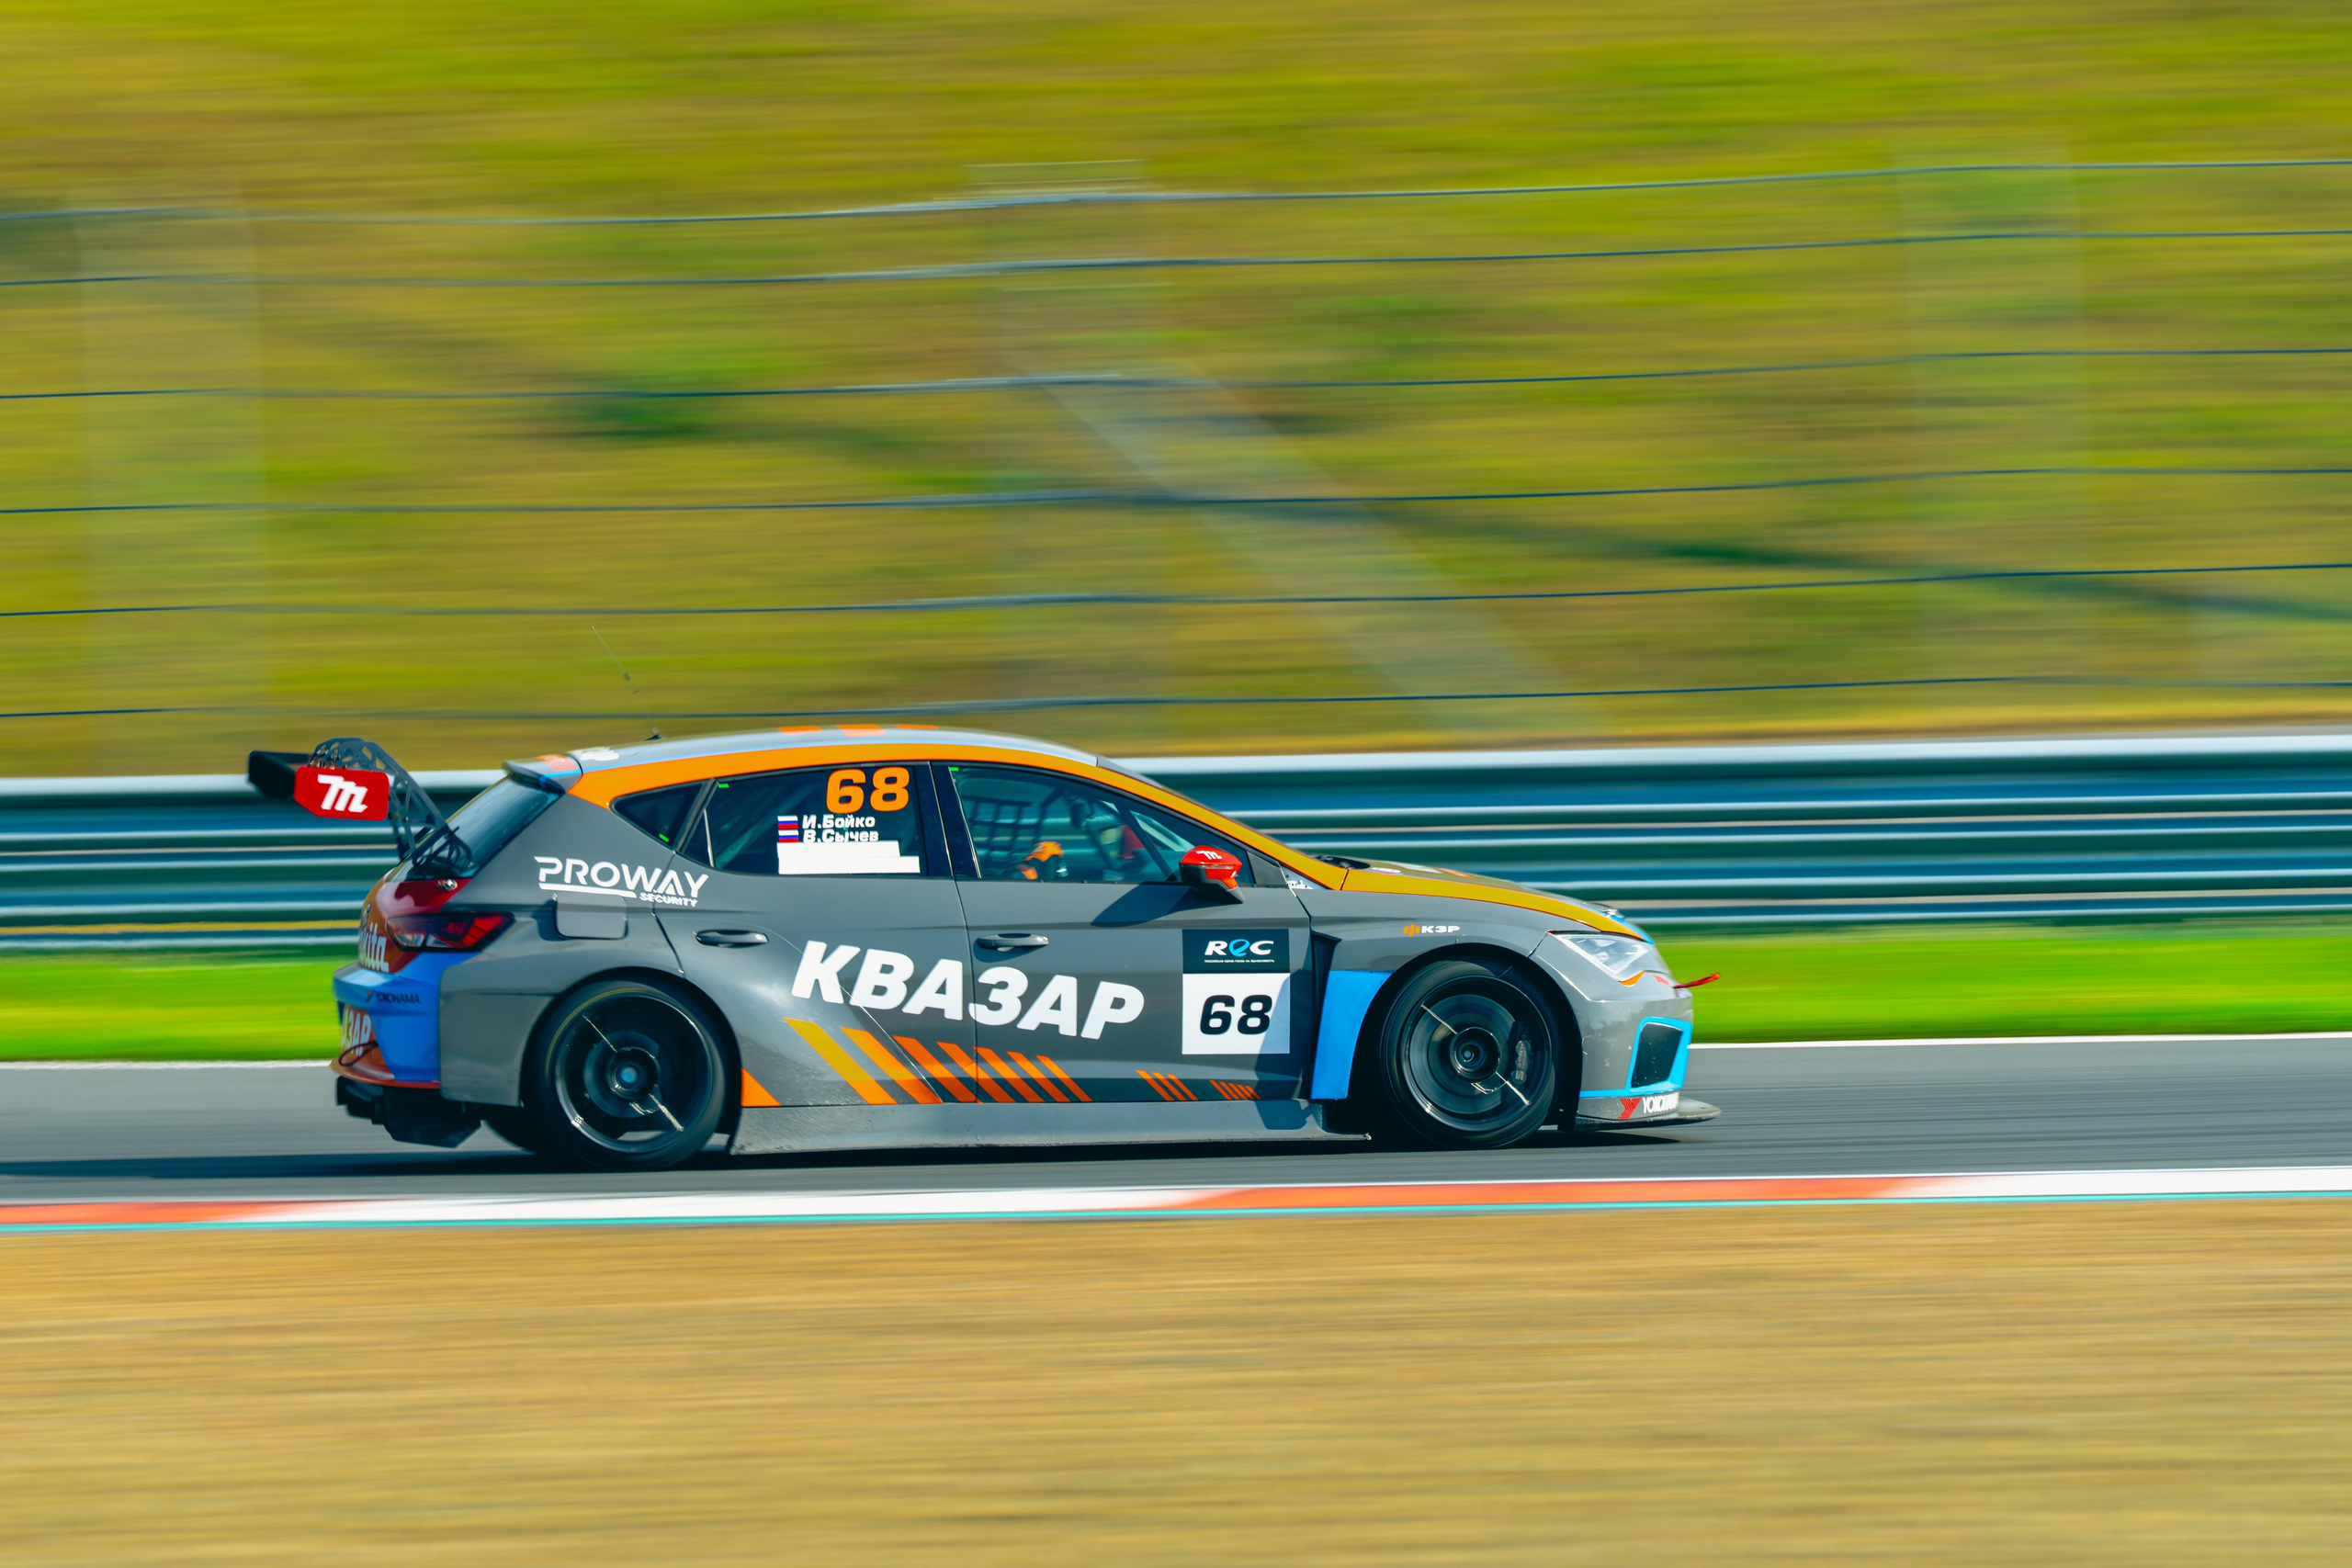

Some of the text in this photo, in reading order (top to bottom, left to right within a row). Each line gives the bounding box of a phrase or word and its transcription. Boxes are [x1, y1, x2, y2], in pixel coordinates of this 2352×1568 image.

[826, 766, 910, 814] 68
[802, 813, 876, 829] И.Бойко
[802, 829, 879, 843] В.Сычев
[533, 855, 710, 898] PROWAY
[639, 892, 698, 908] SECURITY
[791, 940, 1145, 1040] КВАЗАР
[1199, 994, 1273, 1035] 68
